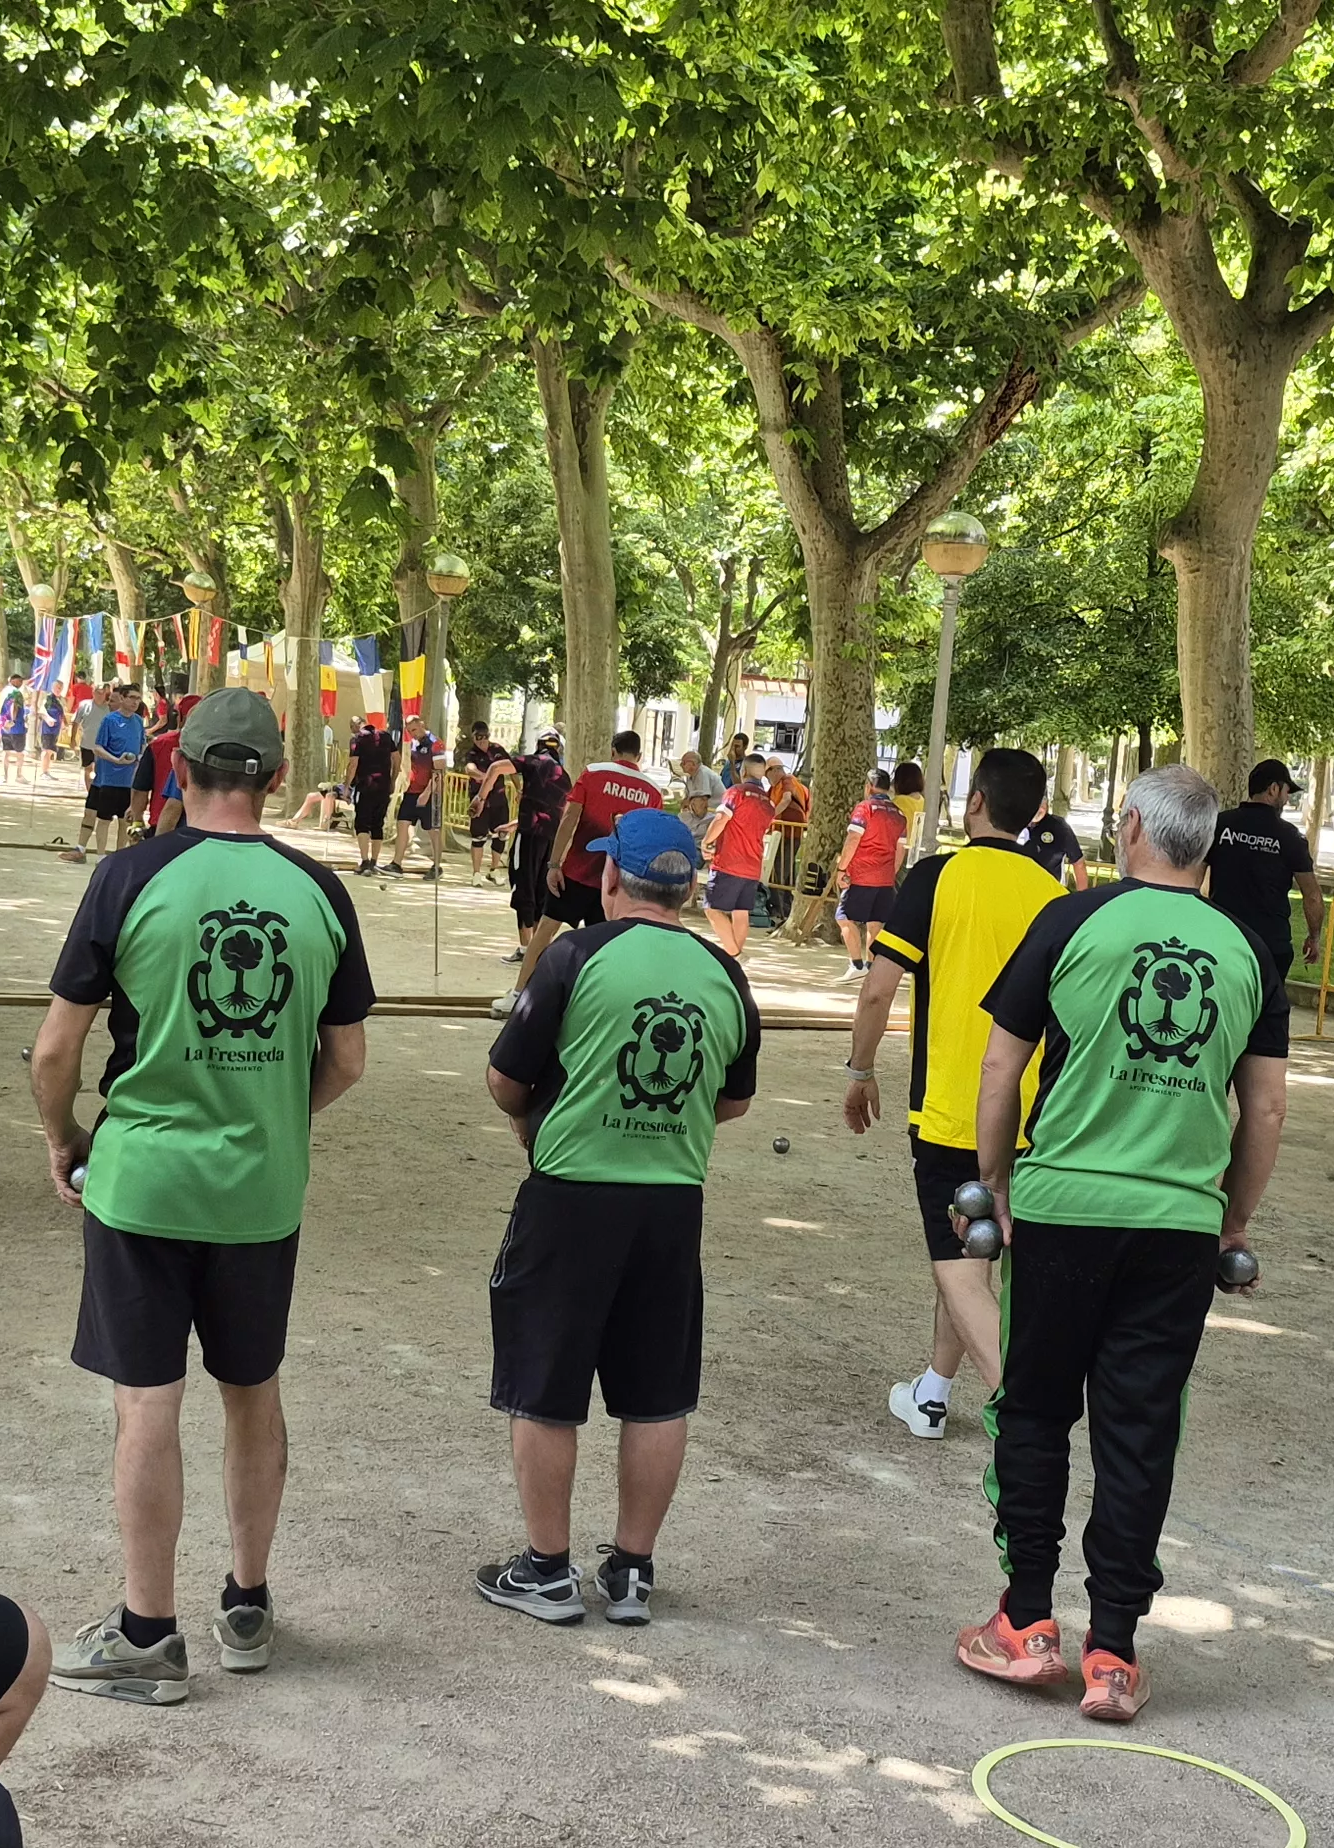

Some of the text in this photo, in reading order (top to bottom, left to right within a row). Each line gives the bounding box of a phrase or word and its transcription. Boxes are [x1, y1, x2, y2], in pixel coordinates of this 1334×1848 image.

[603, 781, 650, 806] ARAGÓN
[1219, 827, 1281, 849] ANDORRA
[185, 1046, 285, 1062] La Fresneda
[1109, 1065, 1207, 1093] La Fresneda
[602, 1113, 688, 1135] La Fresneda
